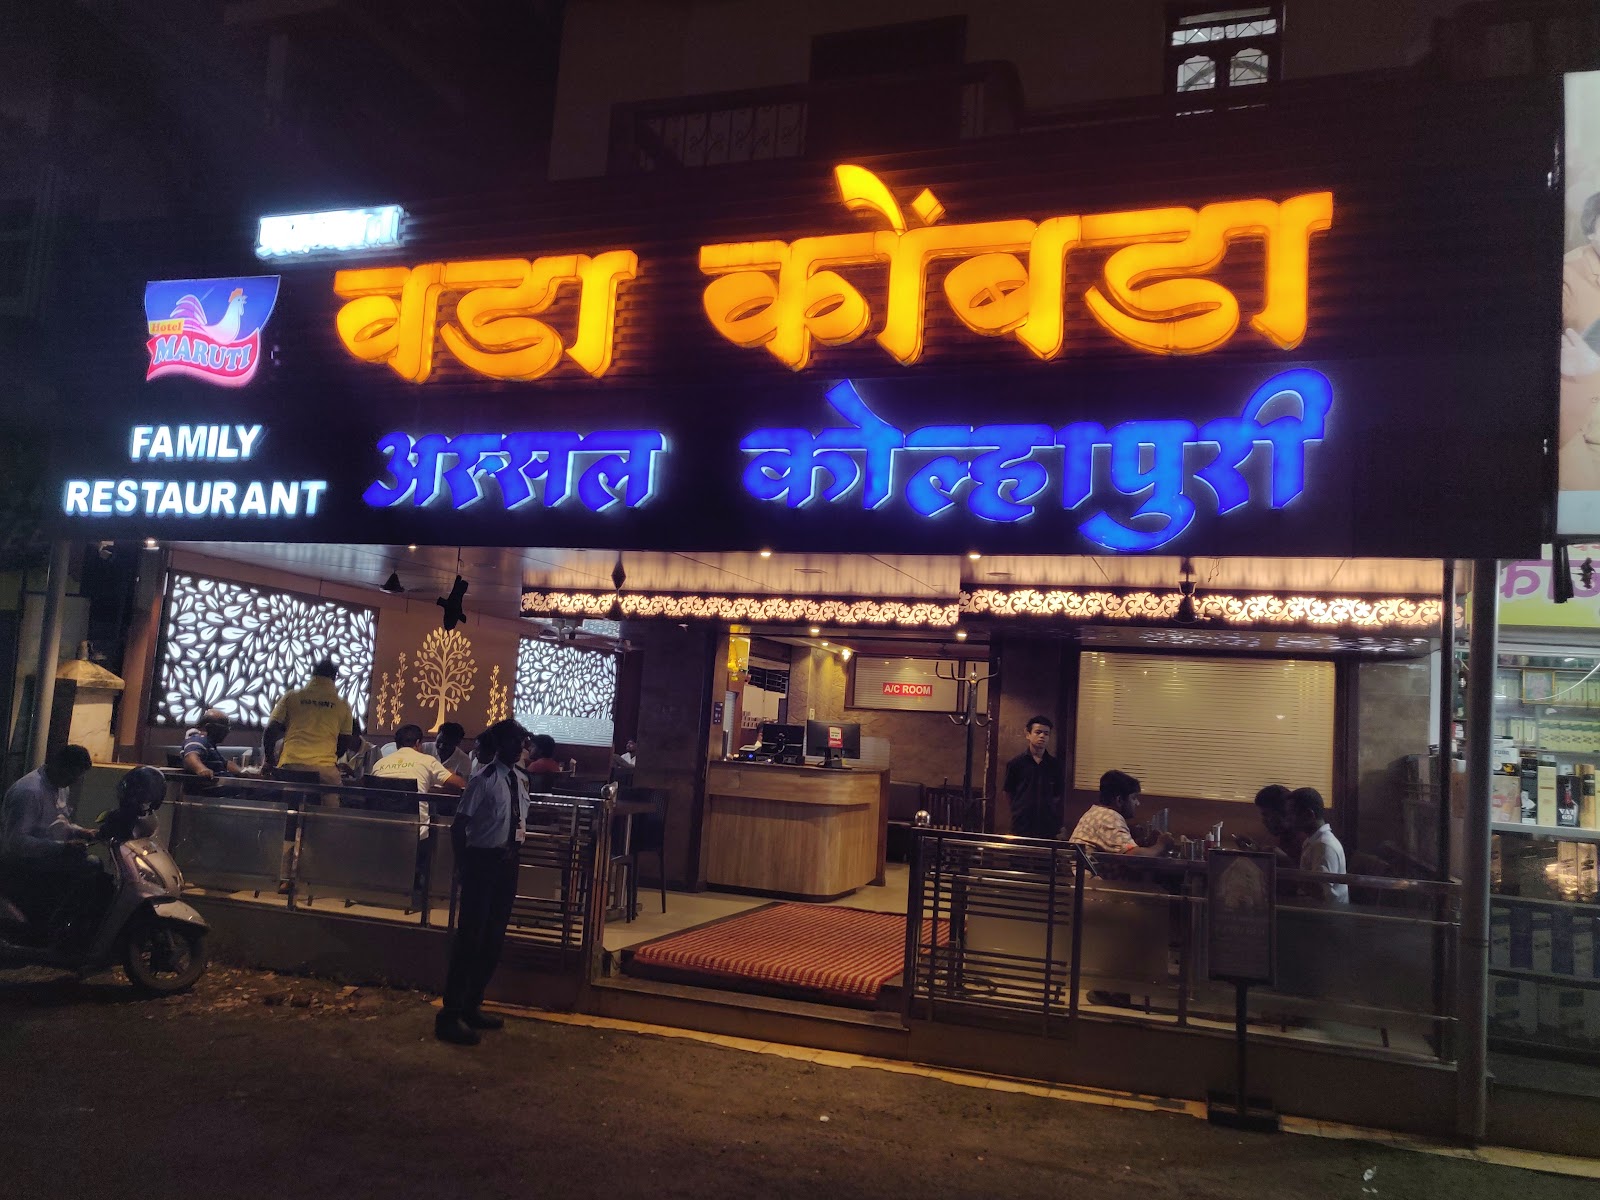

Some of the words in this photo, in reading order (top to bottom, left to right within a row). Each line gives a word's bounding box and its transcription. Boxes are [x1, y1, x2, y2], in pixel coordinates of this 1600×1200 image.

[333, 249, 638, 384] वडा
[699, 164, 1334, 371] कोंबडा
[151, 321, 182, 333] Hotel
[153, 335, 252, 371] MARUTI
[130, 424, 263, 461] FAMILY
[362, 430, 668, 512] अस्सल
[739, 368, 1334, 551] कोल्हापुरी
[64, 479, 328, 517] RESTAURANT
[884, 684, 900, 694] A/C
[902, 685, 931, 695] ROOM
